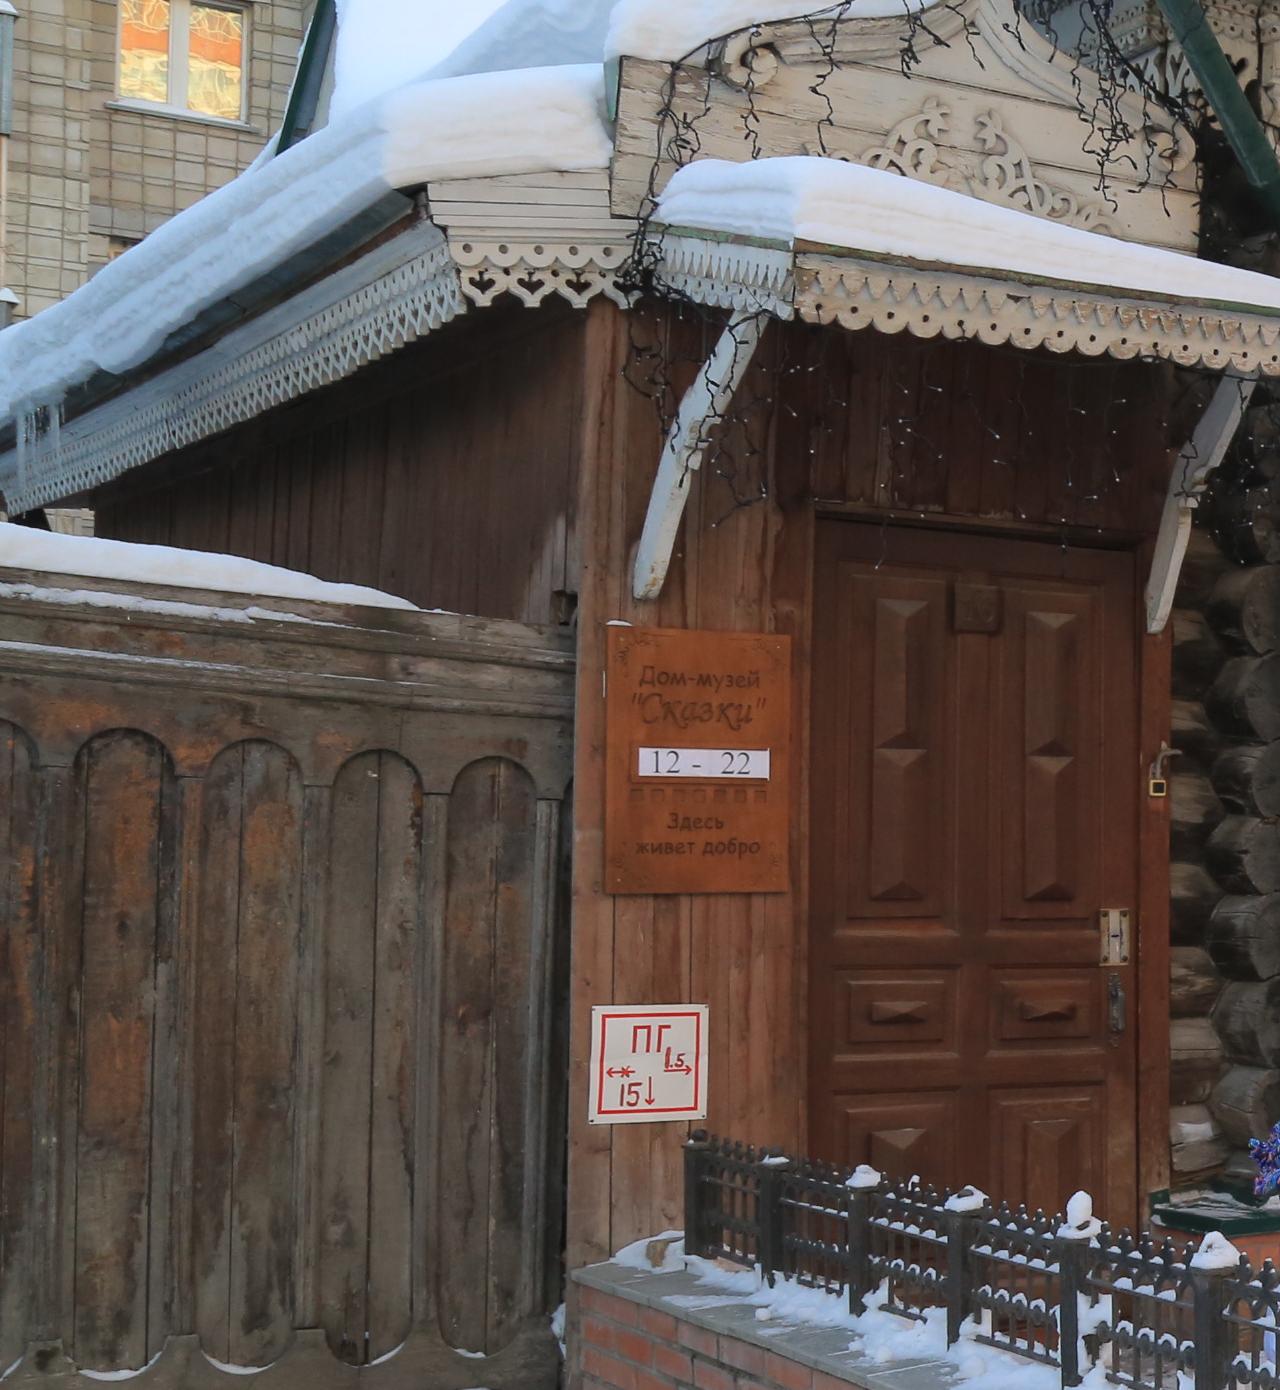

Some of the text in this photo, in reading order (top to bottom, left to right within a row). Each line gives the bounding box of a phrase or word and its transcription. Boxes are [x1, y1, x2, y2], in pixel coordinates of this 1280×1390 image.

[638, 666, 761, 693] Дом-музей
[631, 693, 767, 731] "Сказки"
[652, 750, 680, 774] 12
[720, 751, 751, 775] 22
[667, 813, 725, 832] Здесь
[635, 837, 761, 860] живет добро
[632, 1024, 671, 1053] ПГ
[619, 1082, 643, 1107] 15
